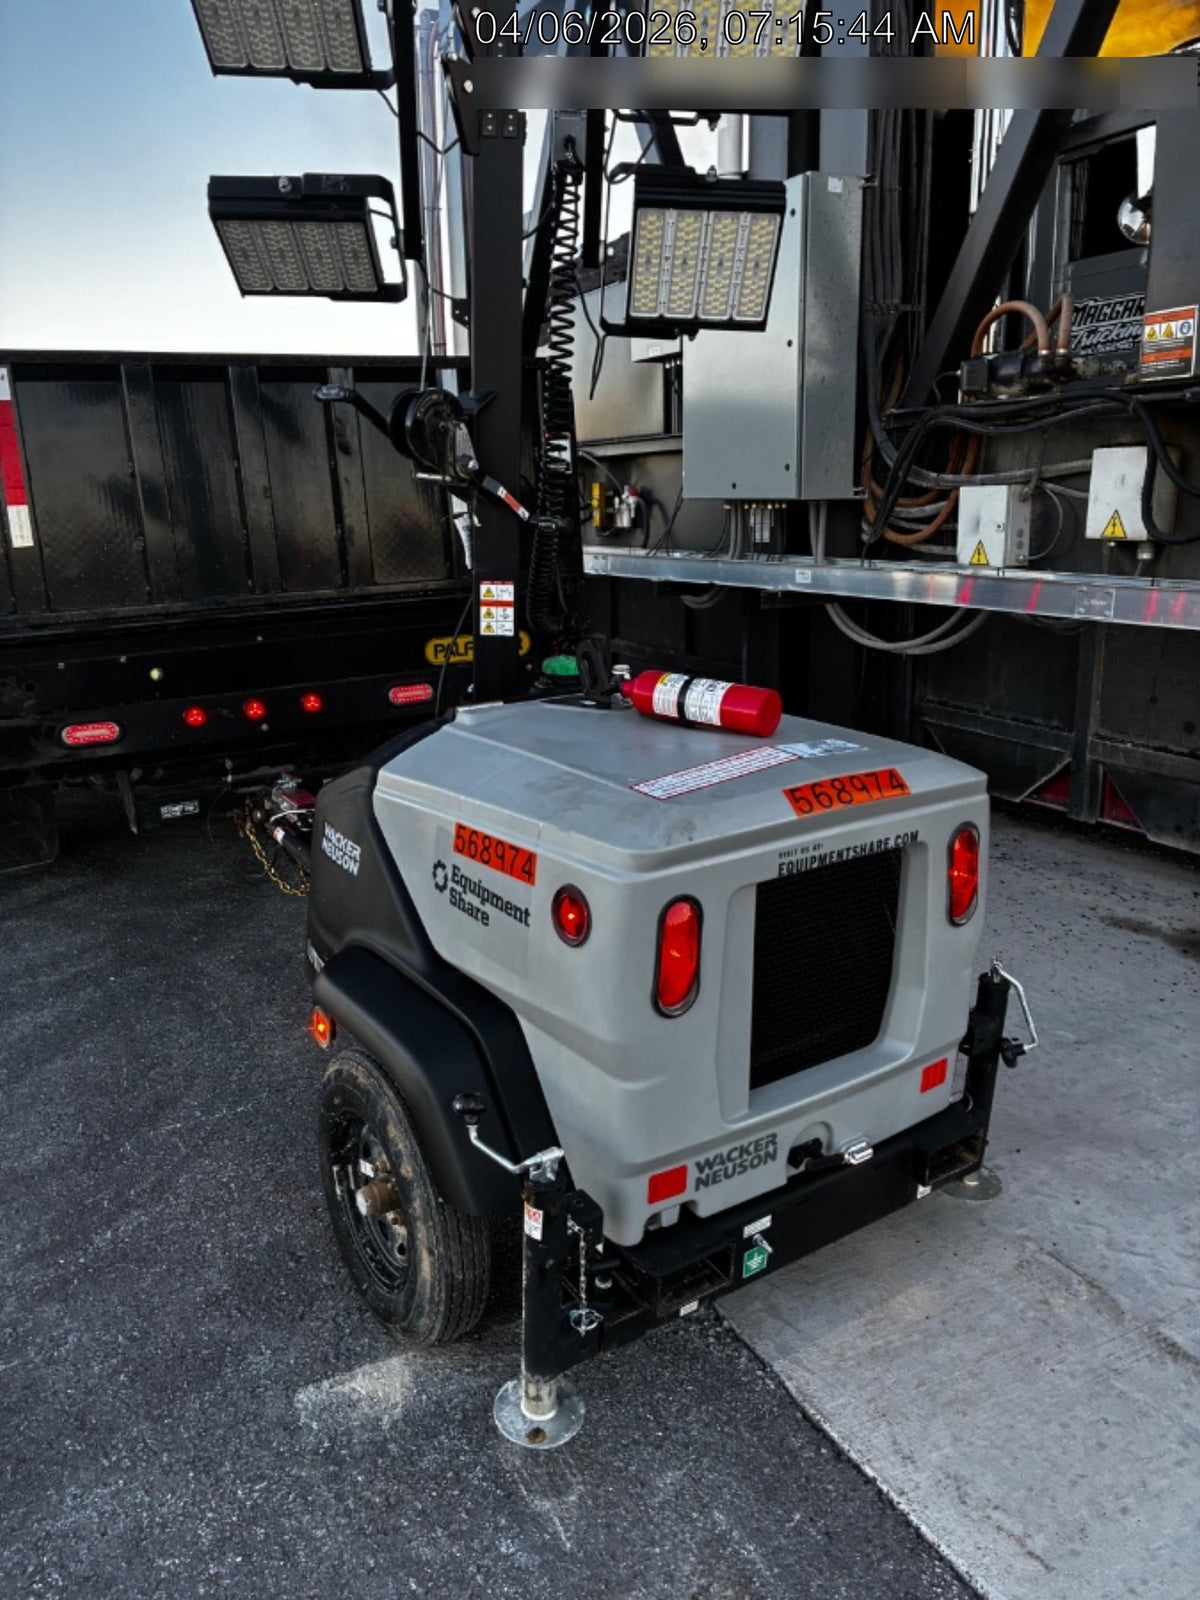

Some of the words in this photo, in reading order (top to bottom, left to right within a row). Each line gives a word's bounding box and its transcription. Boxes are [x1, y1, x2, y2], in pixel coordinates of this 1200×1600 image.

[1071, 322, 1142, 350] Truckin
[788, 769, 905, 814] 568974
[321, 836, 360, 876] NEUSON
[324, 821, 361, 861] WACKER
[454, 823, 534, 884] 568974
[778, 830, 920, 877] EQUIPMENTSHARE.COM
[449, 886, 490, 927] Share
[450, 863, 531, 928] Equipment
[694, 1132, 778, 1174] WACKER
[694, 1146, 778, 1192] NEUSON
